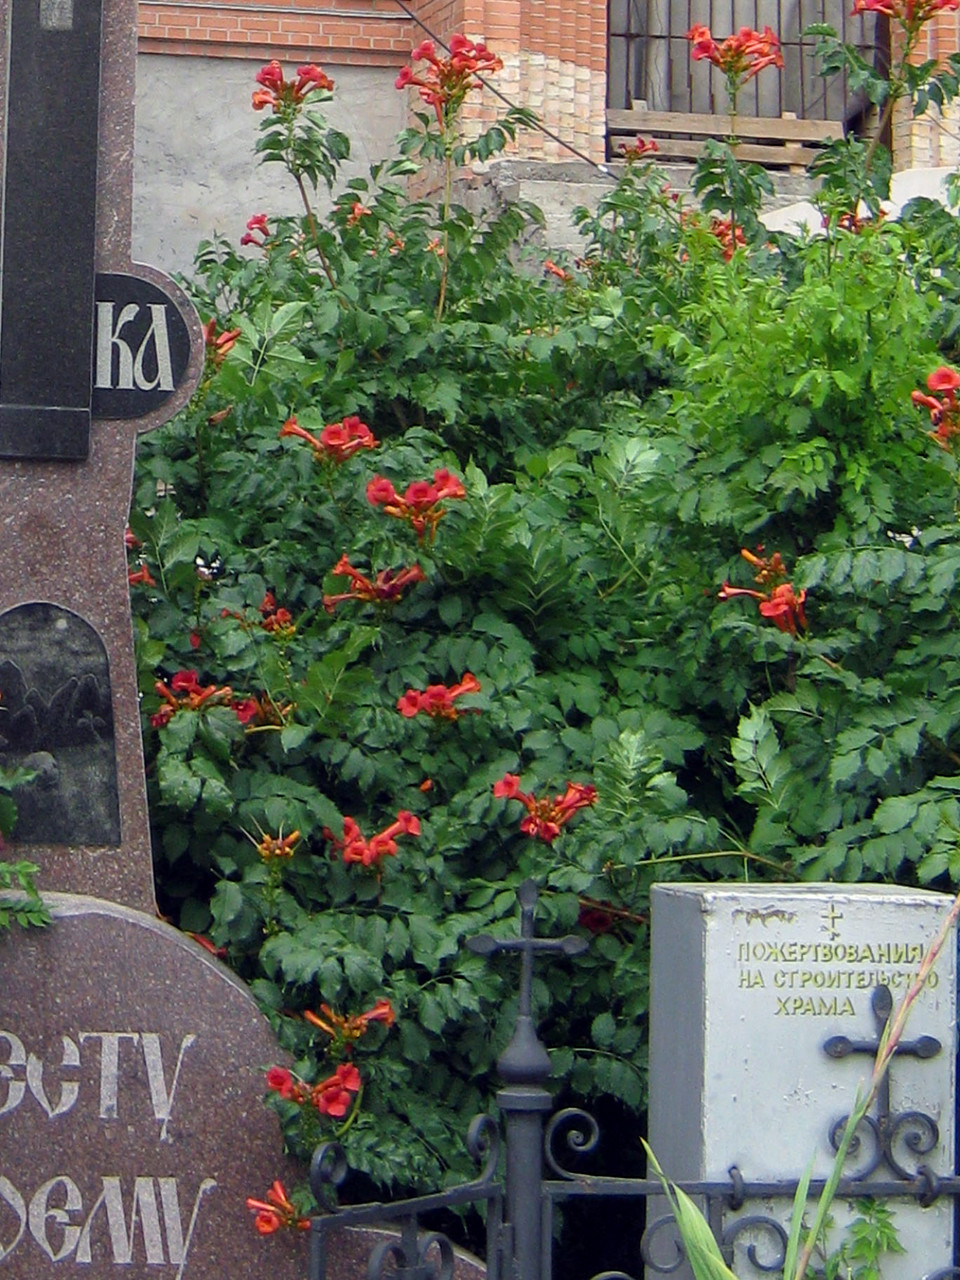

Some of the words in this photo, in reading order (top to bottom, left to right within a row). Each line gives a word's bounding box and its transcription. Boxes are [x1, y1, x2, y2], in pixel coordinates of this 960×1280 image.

[737, 941, 924, 964] ПОЖЕРТВОВАНИЯ
[738, 969, 765, 989] НА
[773, 969, 940, 989] СТРОИТЕЛЬСТО
[774, 996, 856, 1016] ХРАМА
